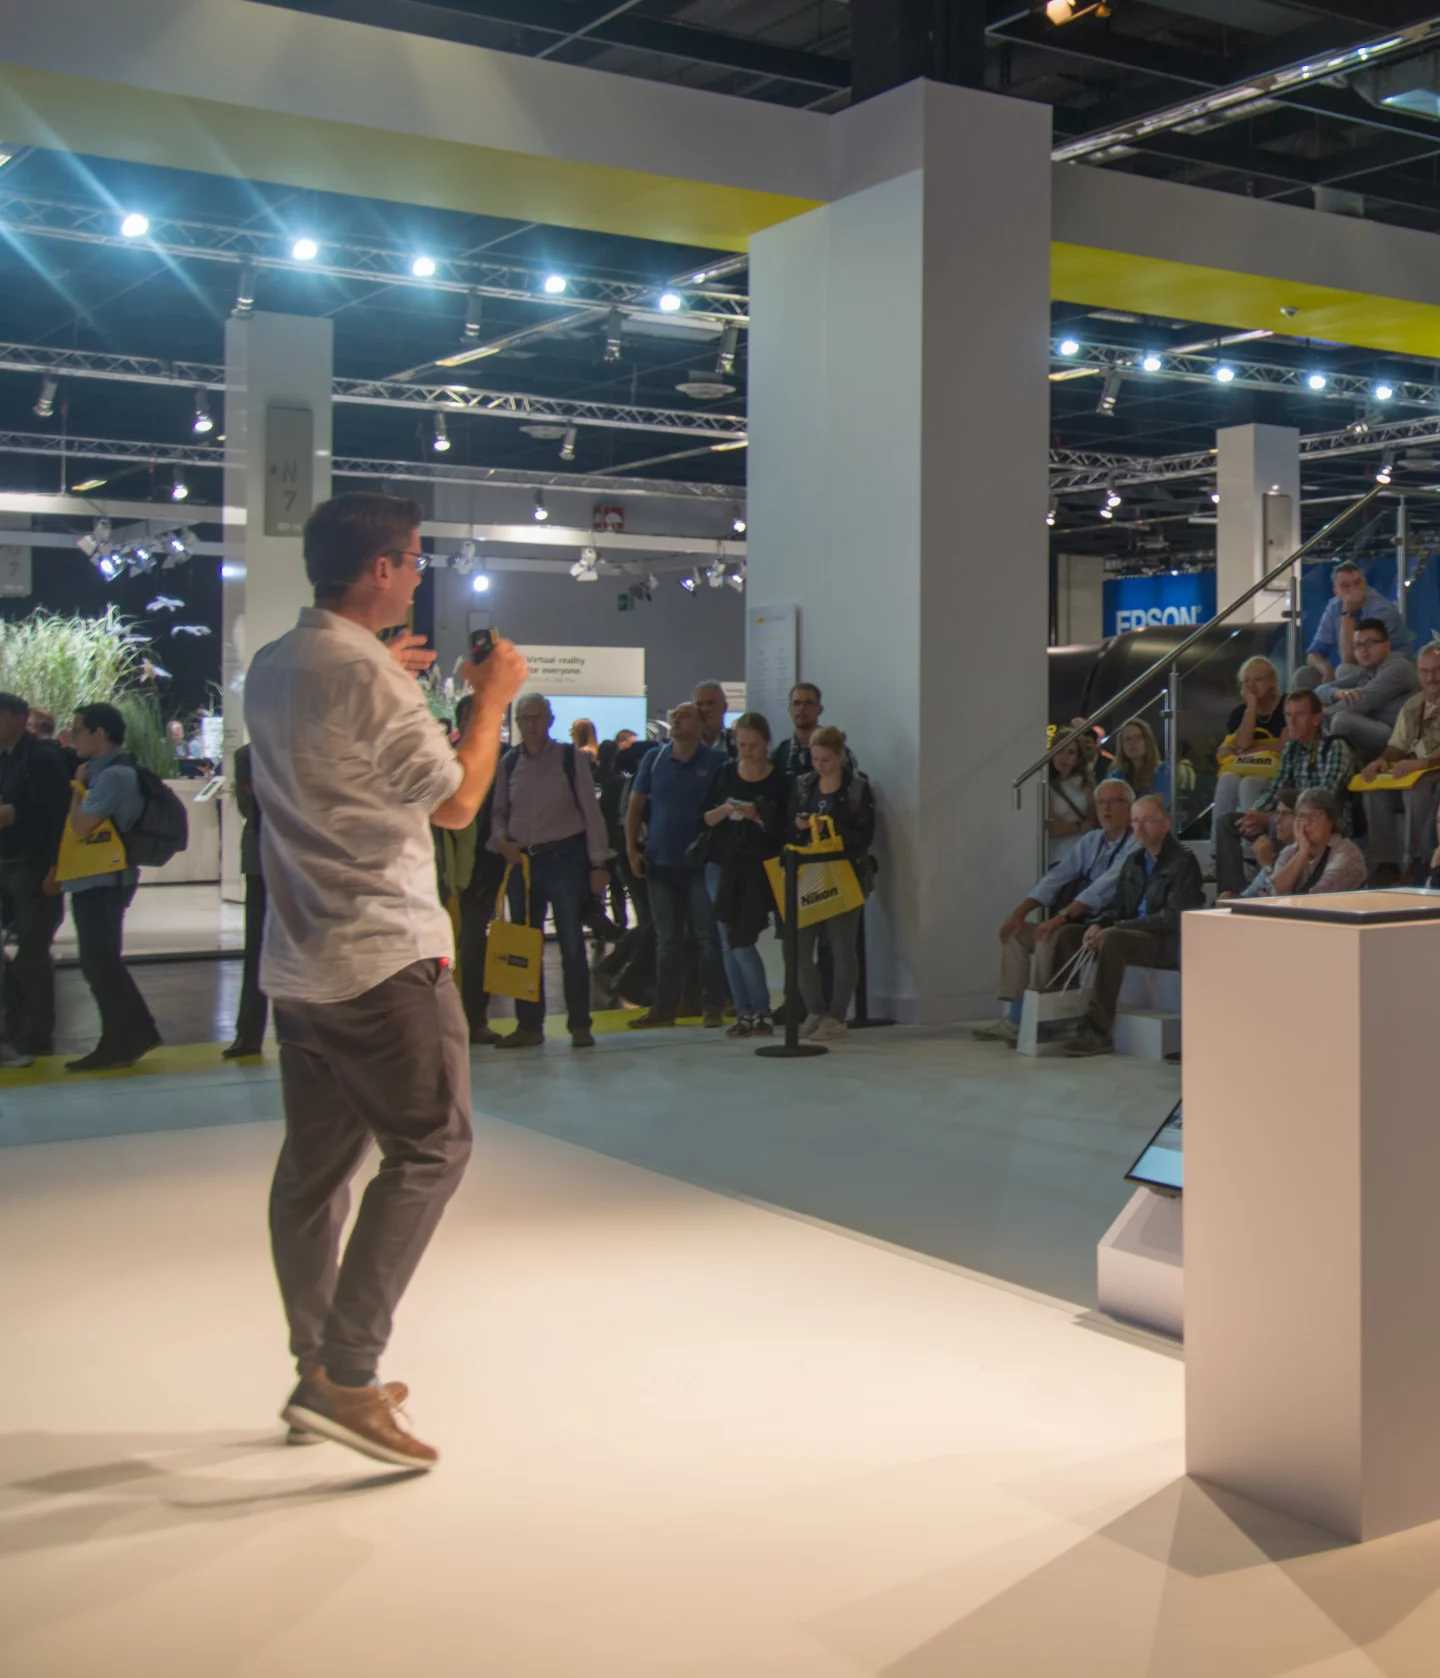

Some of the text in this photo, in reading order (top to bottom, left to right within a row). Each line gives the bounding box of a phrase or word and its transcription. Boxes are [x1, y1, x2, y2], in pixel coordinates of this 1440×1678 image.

[1116, 606, 1197, 636] EPSON
[527, 655, 585, 666] Virtual reality
[801, 886, 839, 908] Nikon
